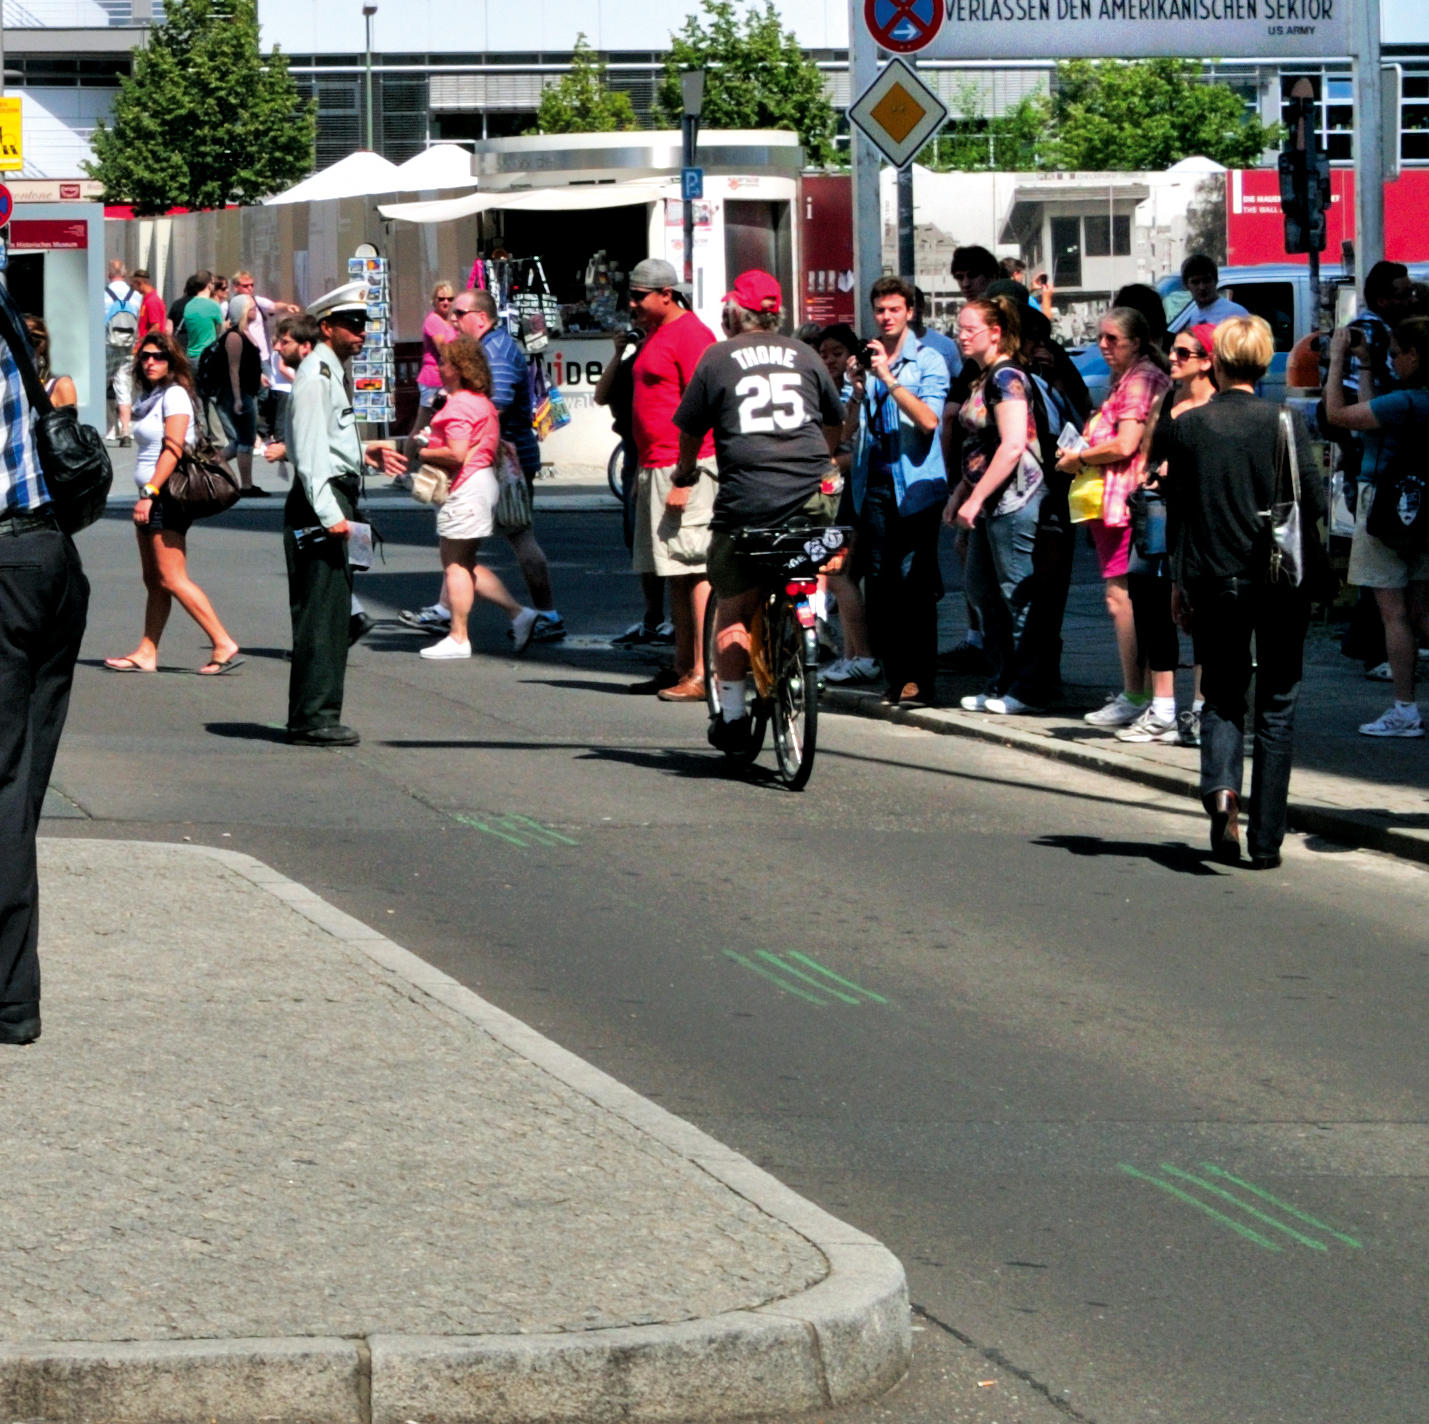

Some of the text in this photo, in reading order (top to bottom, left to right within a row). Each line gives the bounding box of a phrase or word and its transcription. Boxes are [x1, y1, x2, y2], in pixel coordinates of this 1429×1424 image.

[1268, 26, 1315, 35] US ARMY
[731, 345, 797, 370] THOME
[735, 372, 805, 433] 25
